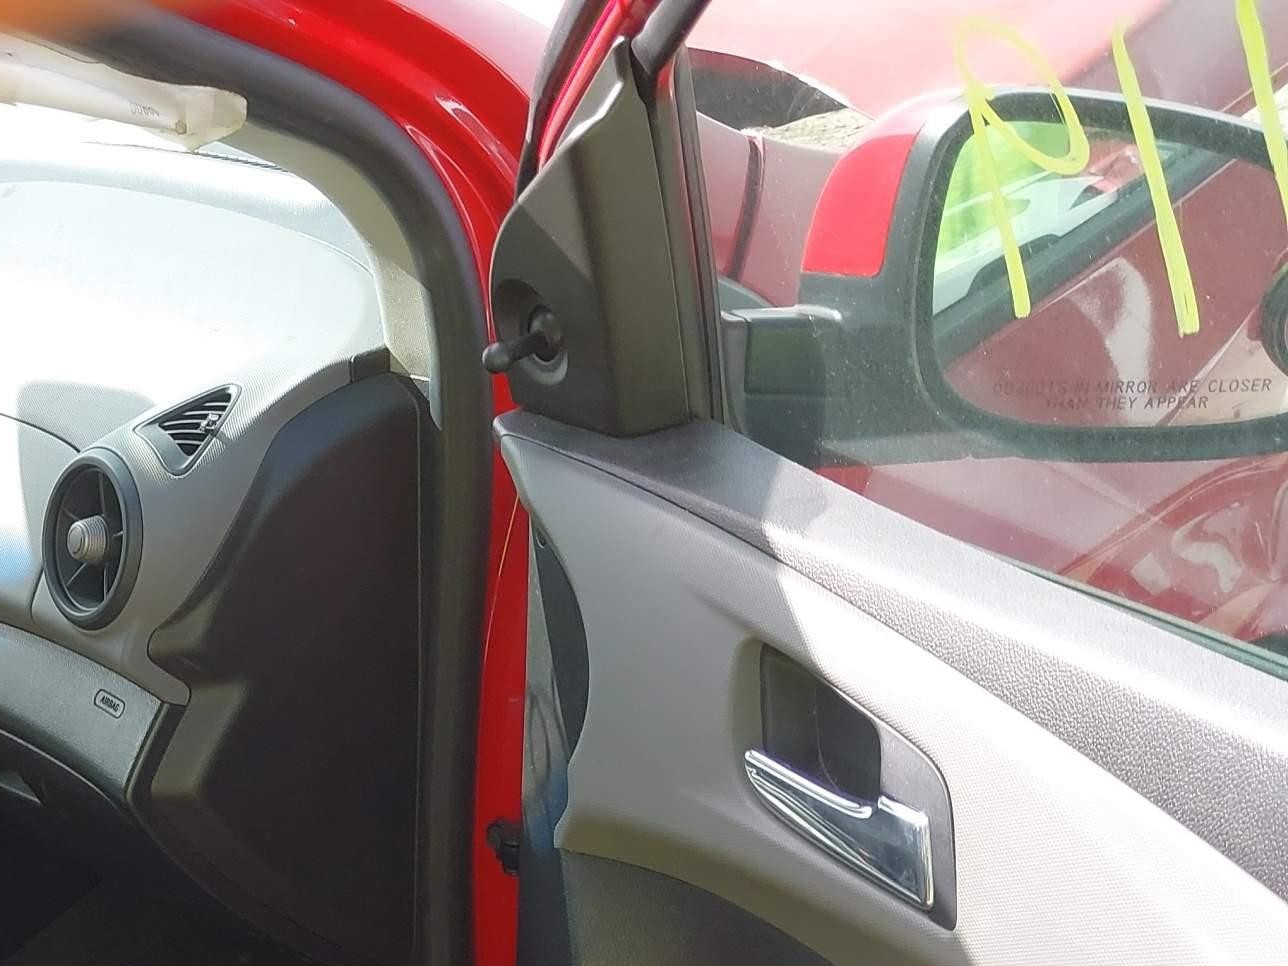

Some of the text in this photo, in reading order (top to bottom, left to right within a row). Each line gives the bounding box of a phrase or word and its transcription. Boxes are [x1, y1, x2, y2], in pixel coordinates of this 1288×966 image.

[992, 378, 1273, 396] OBJECTS IN MIRROR ARE CLOSER
[1046, 396, 1209, 410] THAN THEY APPEAR
[100, 695, 120, 713] AIRBAG
